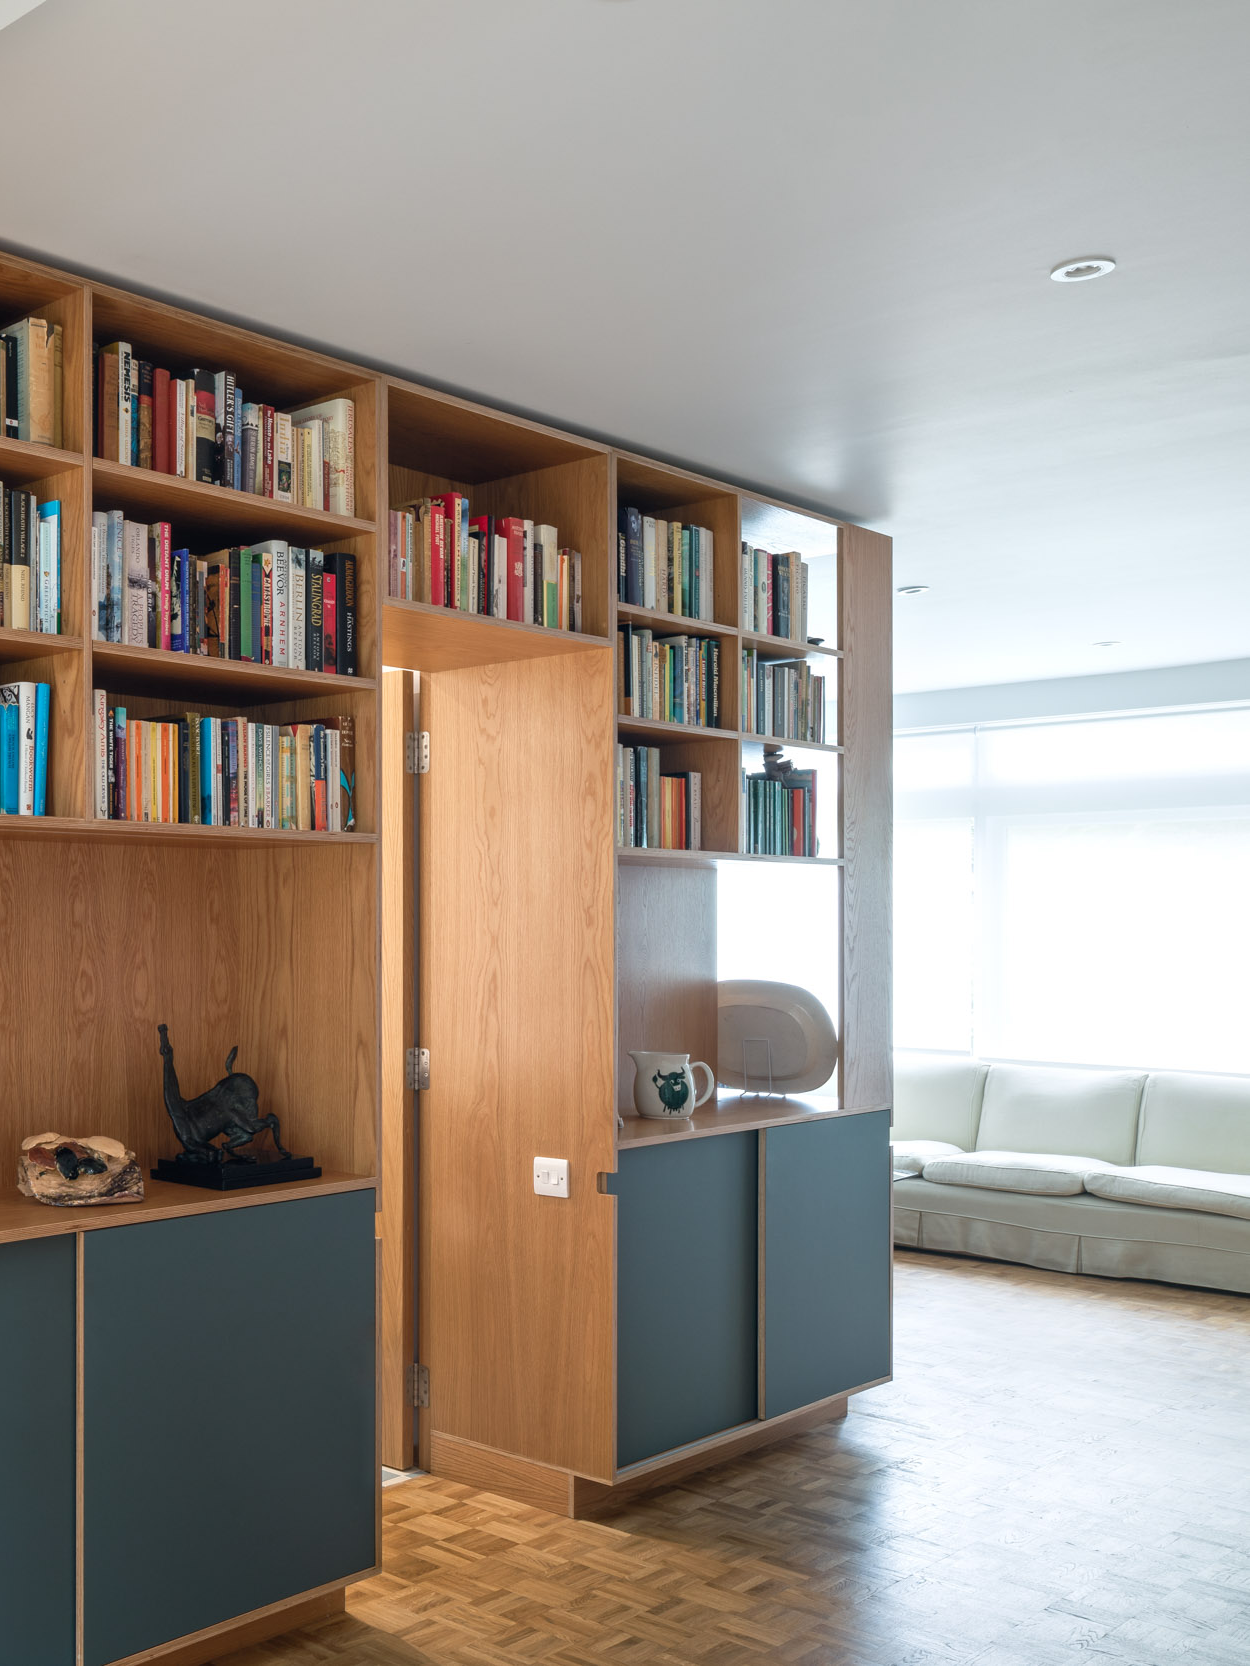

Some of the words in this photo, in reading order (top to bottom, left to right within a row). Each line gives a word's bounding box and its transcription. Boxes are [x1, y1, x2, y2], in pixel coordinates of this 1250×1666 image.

[226, 375, 235, 413] HITLER'S
[226, 415, 235, 434] GIFT
[279, 417, 290, 455] India
[295, 573, 304, 622] BERLIN
[311, 574, 322, 626] STALINGRAD
[345, 560, 355, 607] ARMAGEDDON
